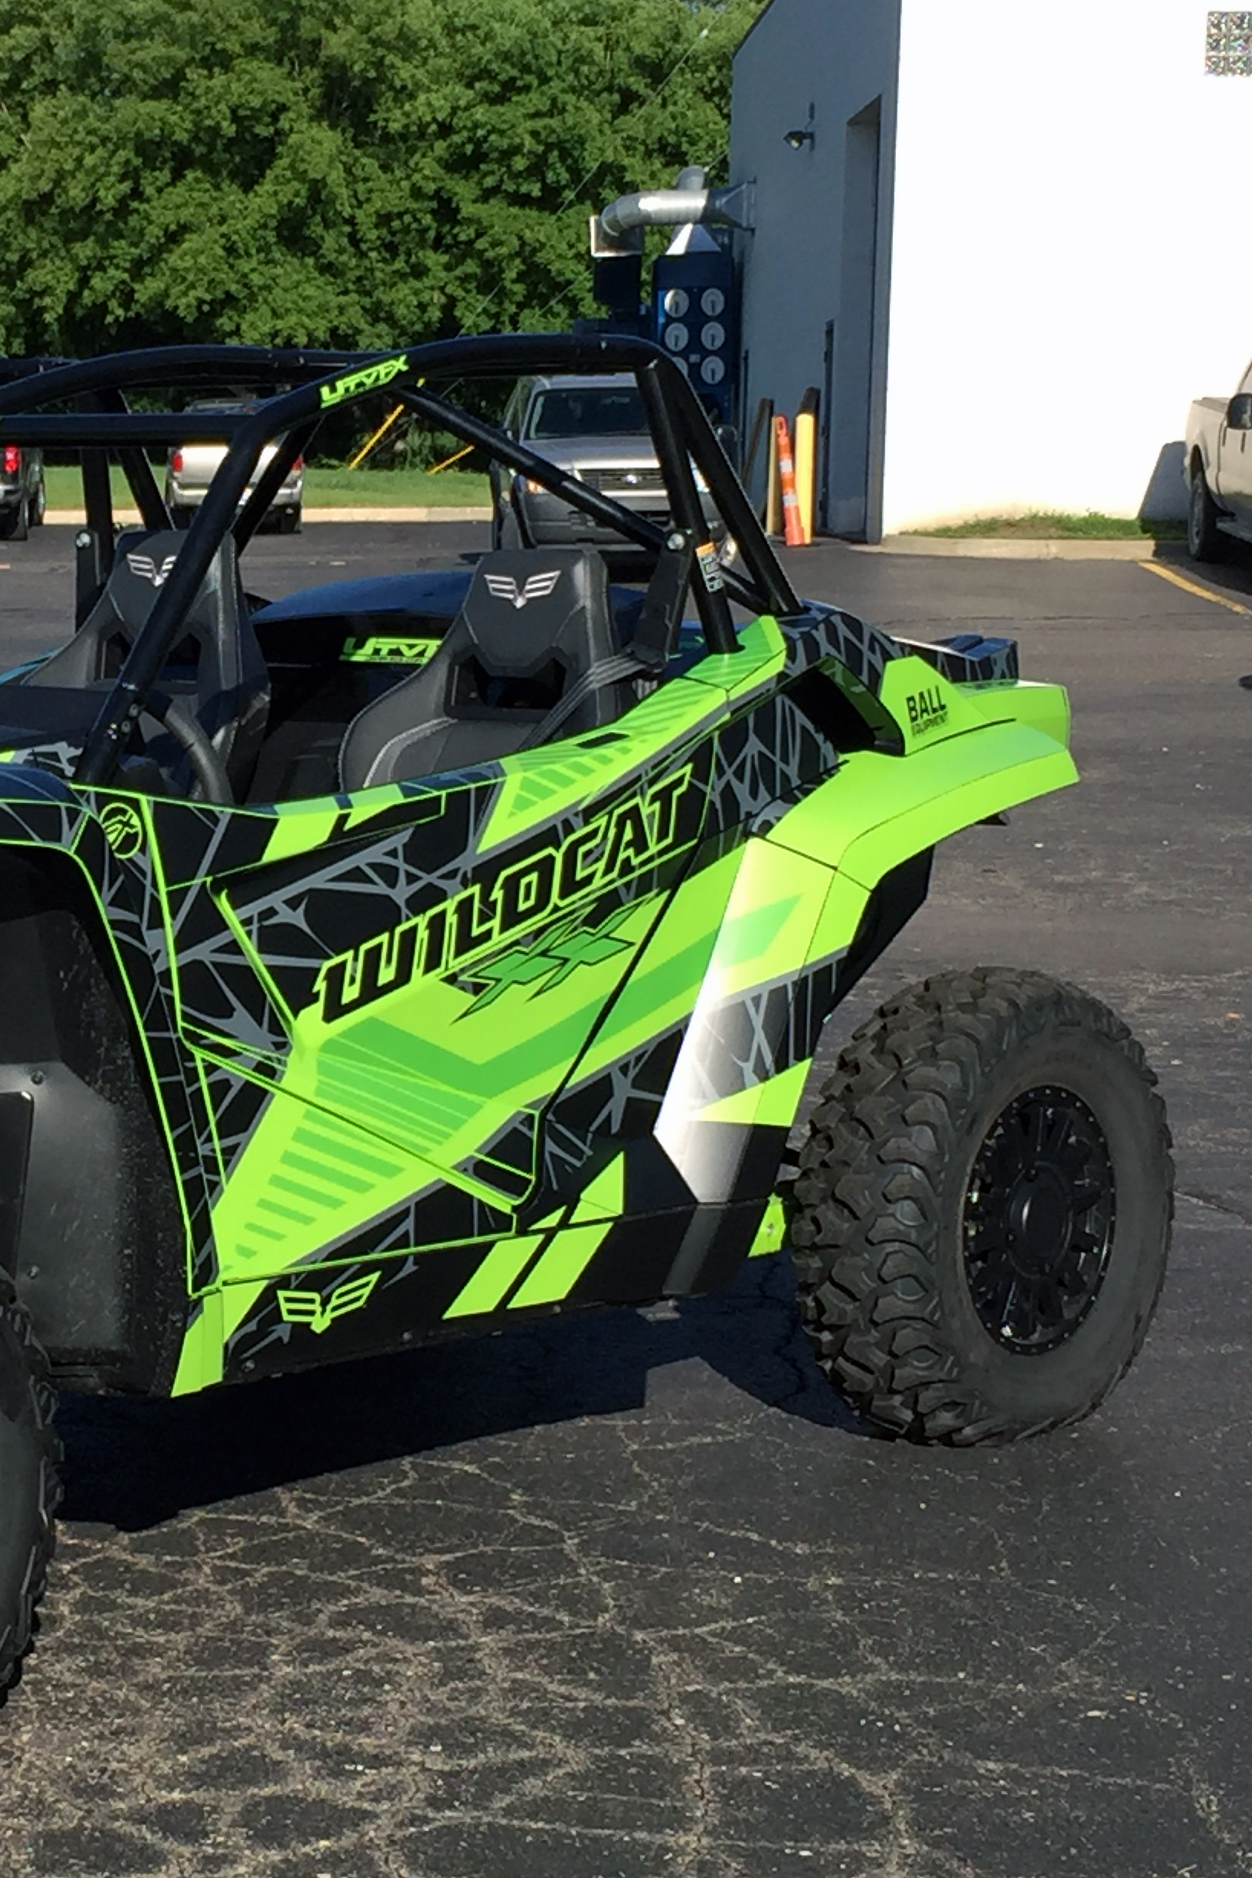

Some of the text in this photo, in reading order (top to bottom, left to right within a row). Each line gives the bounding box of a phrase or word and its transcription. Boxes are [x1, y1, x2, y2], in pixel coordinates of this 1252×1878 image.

[320, 354, 409, 406] UTVFX
[906, 685, 947, 723] BALL
[313, 763, 692, 1024] WILDCAT
